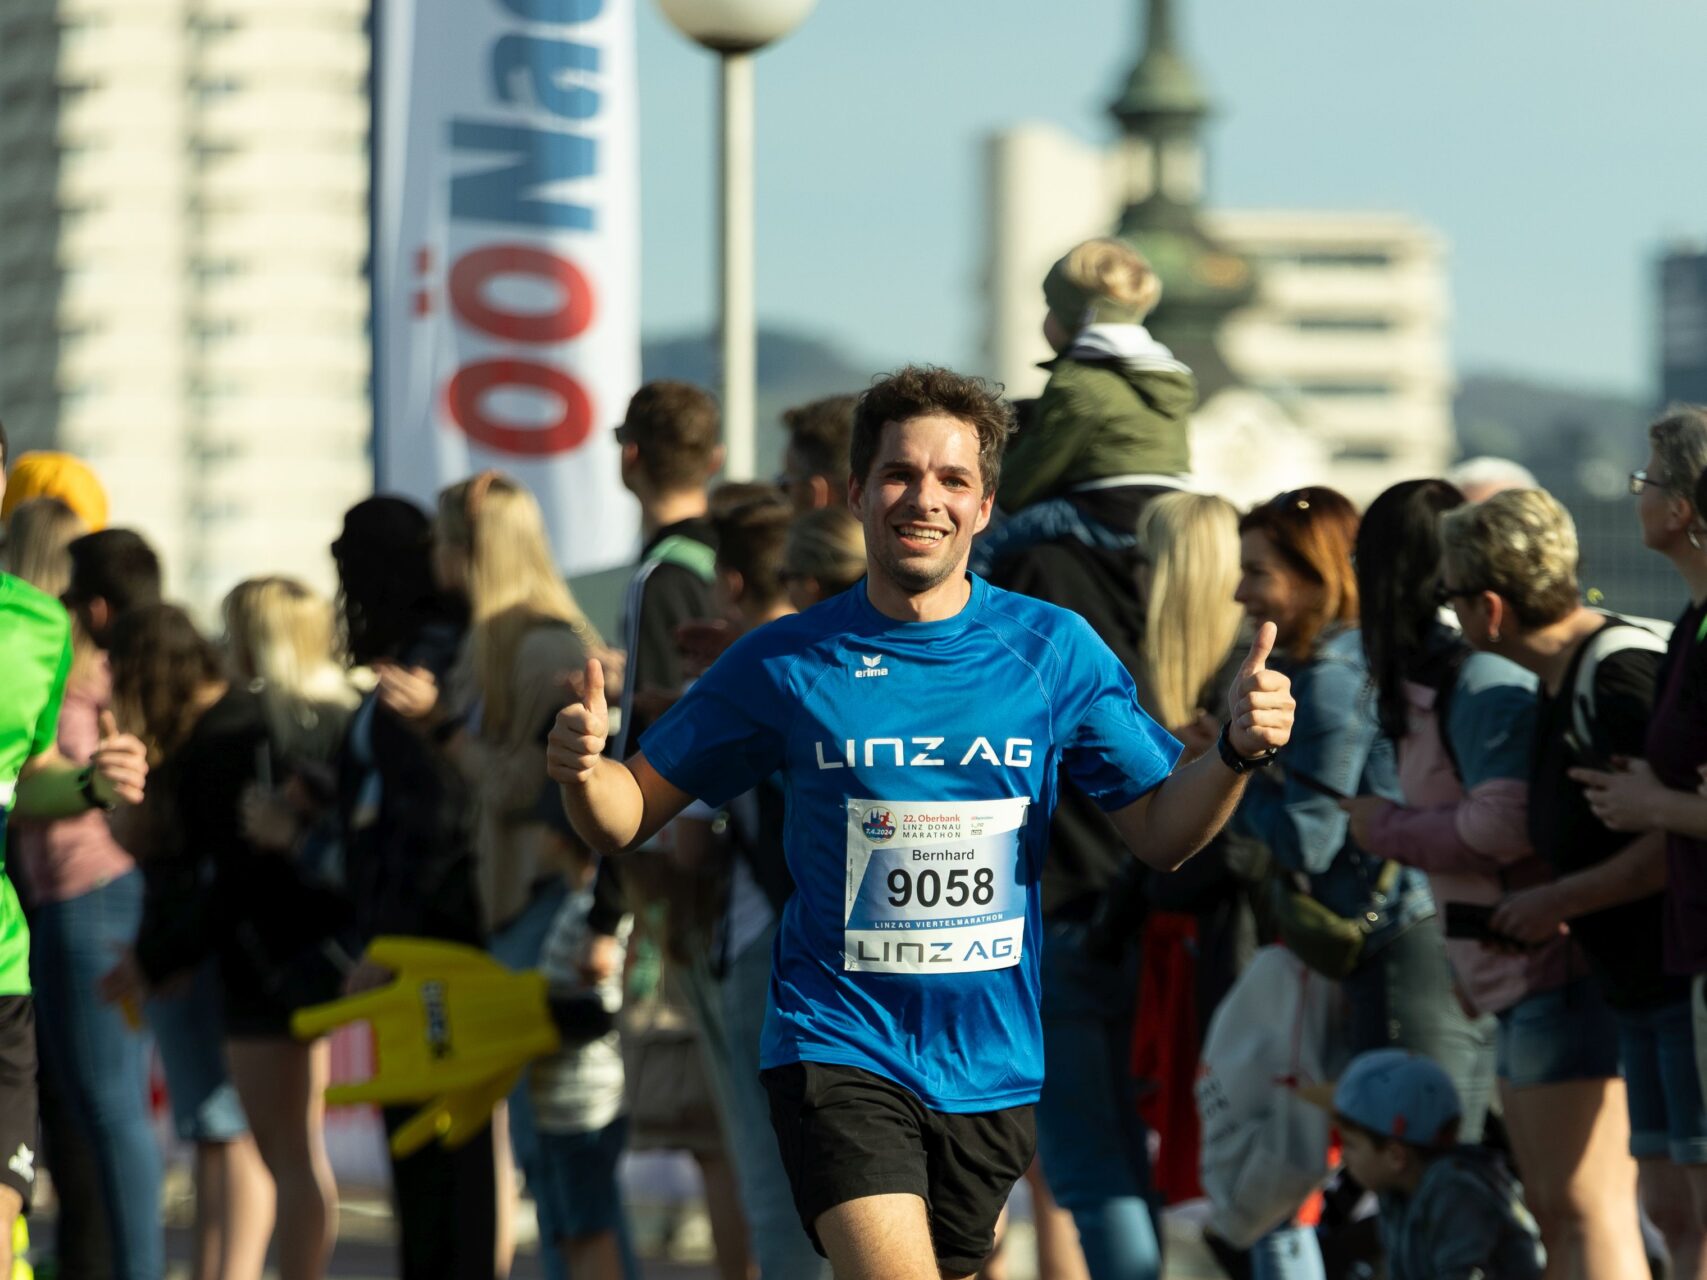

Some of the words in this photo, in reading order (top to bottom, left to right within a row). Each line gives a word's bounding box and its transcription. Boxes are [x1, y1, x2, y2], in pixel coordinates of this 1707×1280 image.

[414, 0, 604, 462] OÖNa
[855, 668, 888, 678] erima
[960, 736, 1033, 768] AG
[903, 814, 917, 823] 22.
[918, 814, 961, 823] Oberbank
[865, 828, 892, 836] 7.4.2024
[903, 823, 923, 831] LINZ
[927, 823, 961, 831] DONAU
[912, 848, 975, 861] Bernhard
[887, 868, 993, 907] 9058
[915, 913, 1004, 928] VIERTELMARATHON
[963, 937, 1013, 962] AG
